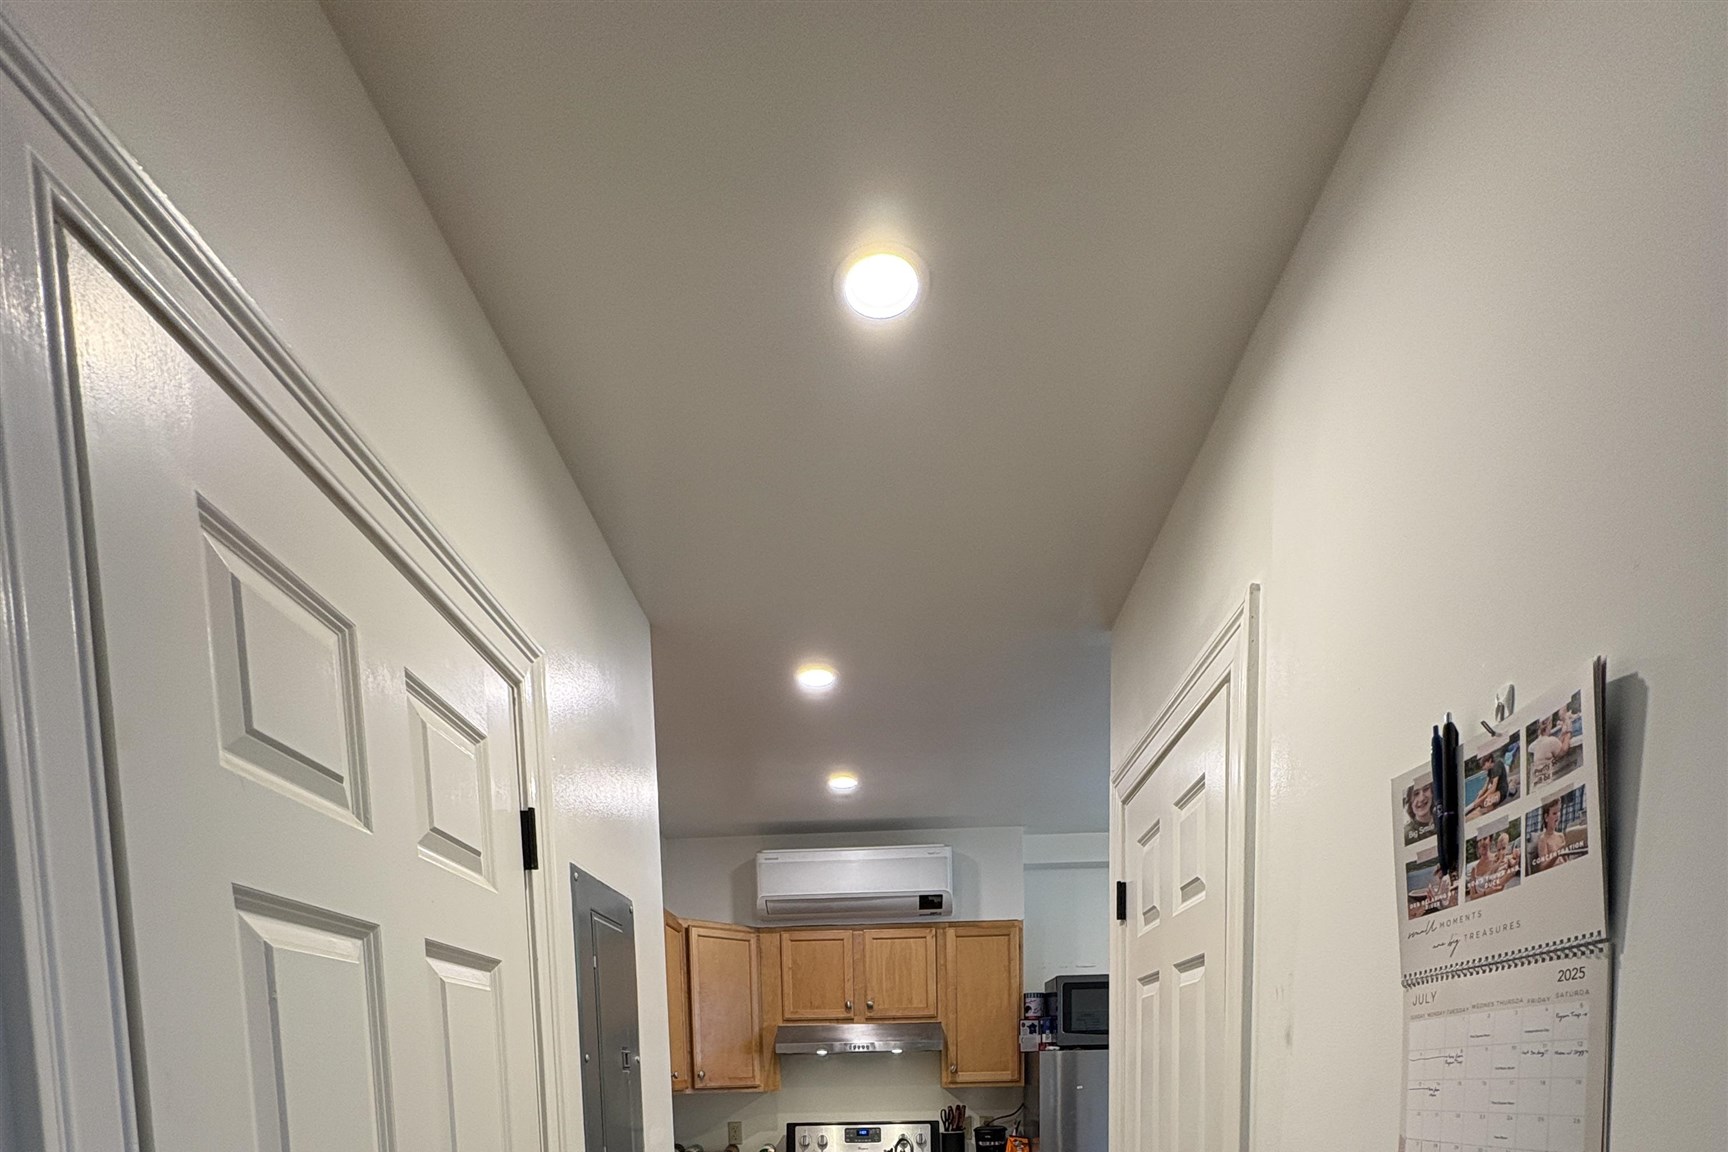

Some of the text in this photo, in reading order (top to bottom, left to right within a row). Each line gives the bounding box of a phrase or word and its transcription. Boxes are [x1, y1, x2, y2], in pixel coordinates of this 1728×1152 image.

[1407, 910, 1483, 939] small MOMENTS
[1463, 919, 1522, 940] TREASURES
[1557, 966, 1586, 983] 2025
[1412, 991, 1437, 1007] JULY
